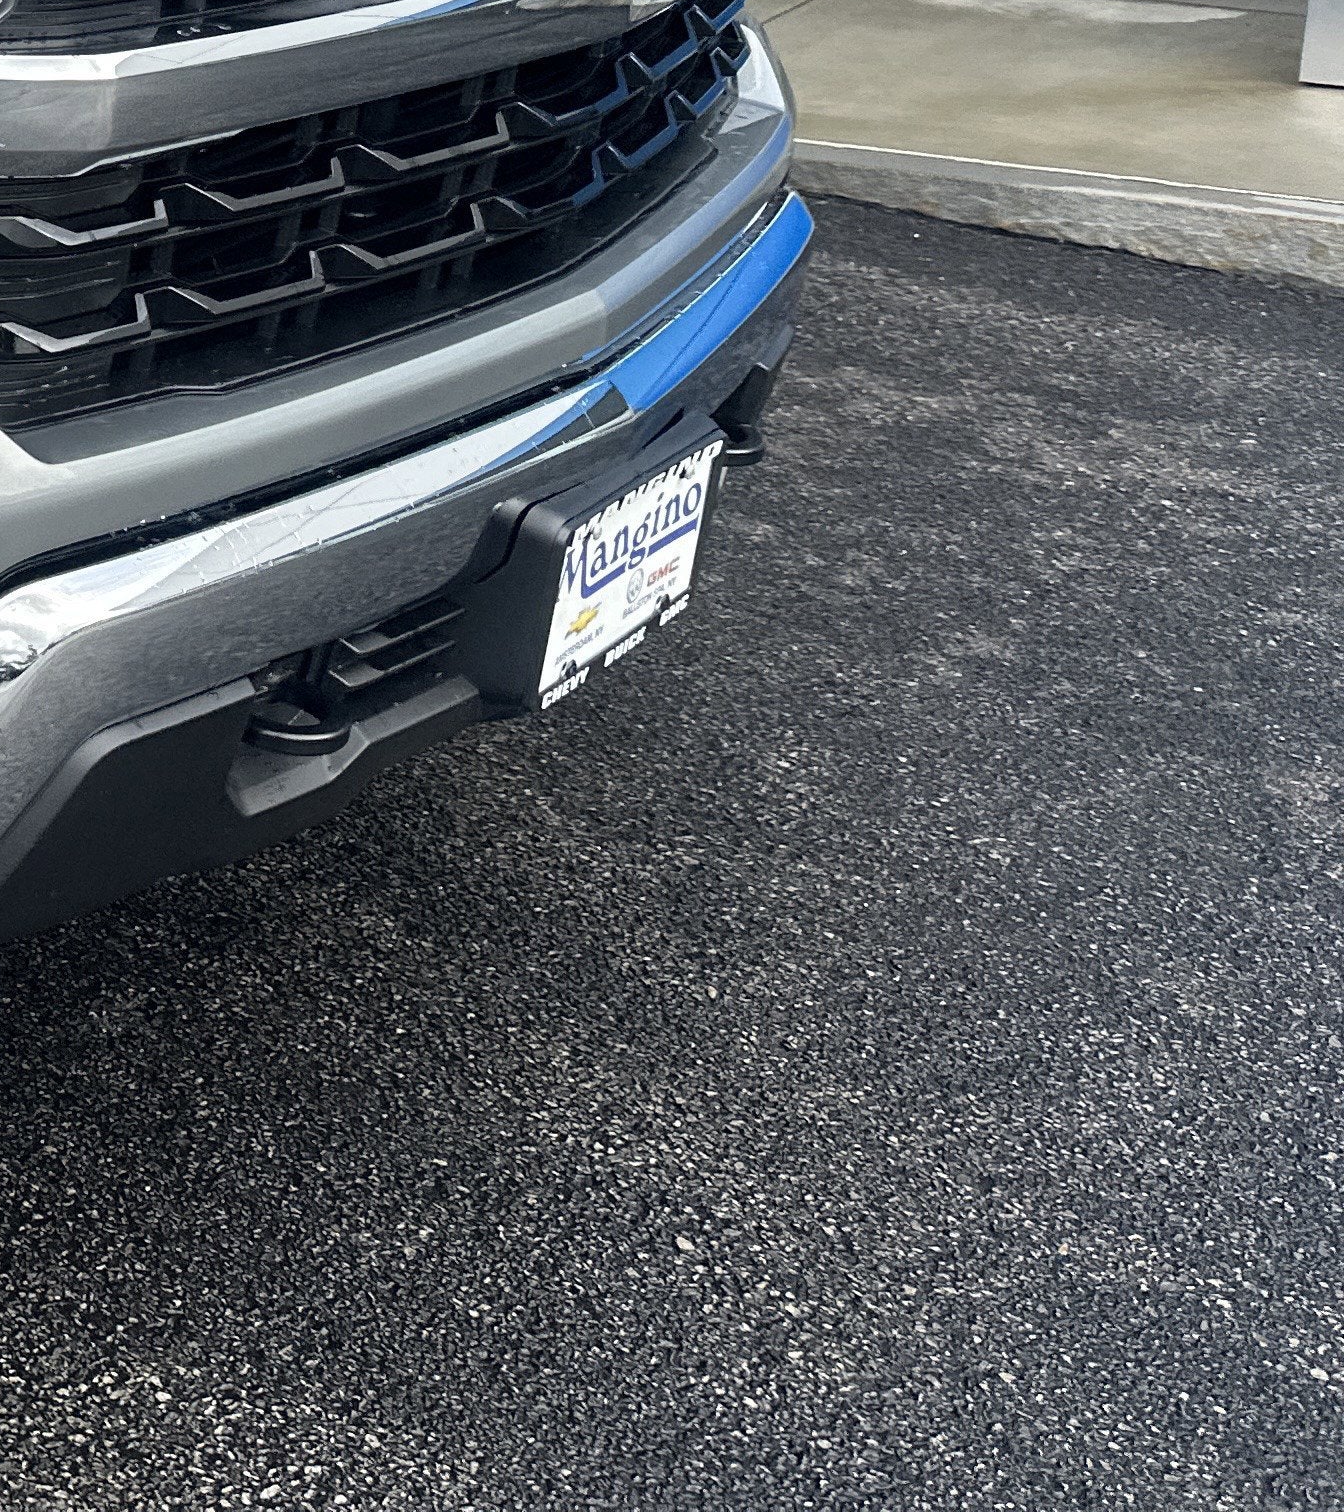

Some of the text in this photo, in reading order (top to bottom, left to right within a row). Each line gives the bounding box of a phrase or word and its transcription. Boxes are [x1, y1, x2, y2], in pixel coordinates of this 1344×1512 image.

[559, 482, 702, 598] Mangino
[647, 556, 680, 587] GMC
[541, 594, 690, 709] CHEVY BUICK GMC
